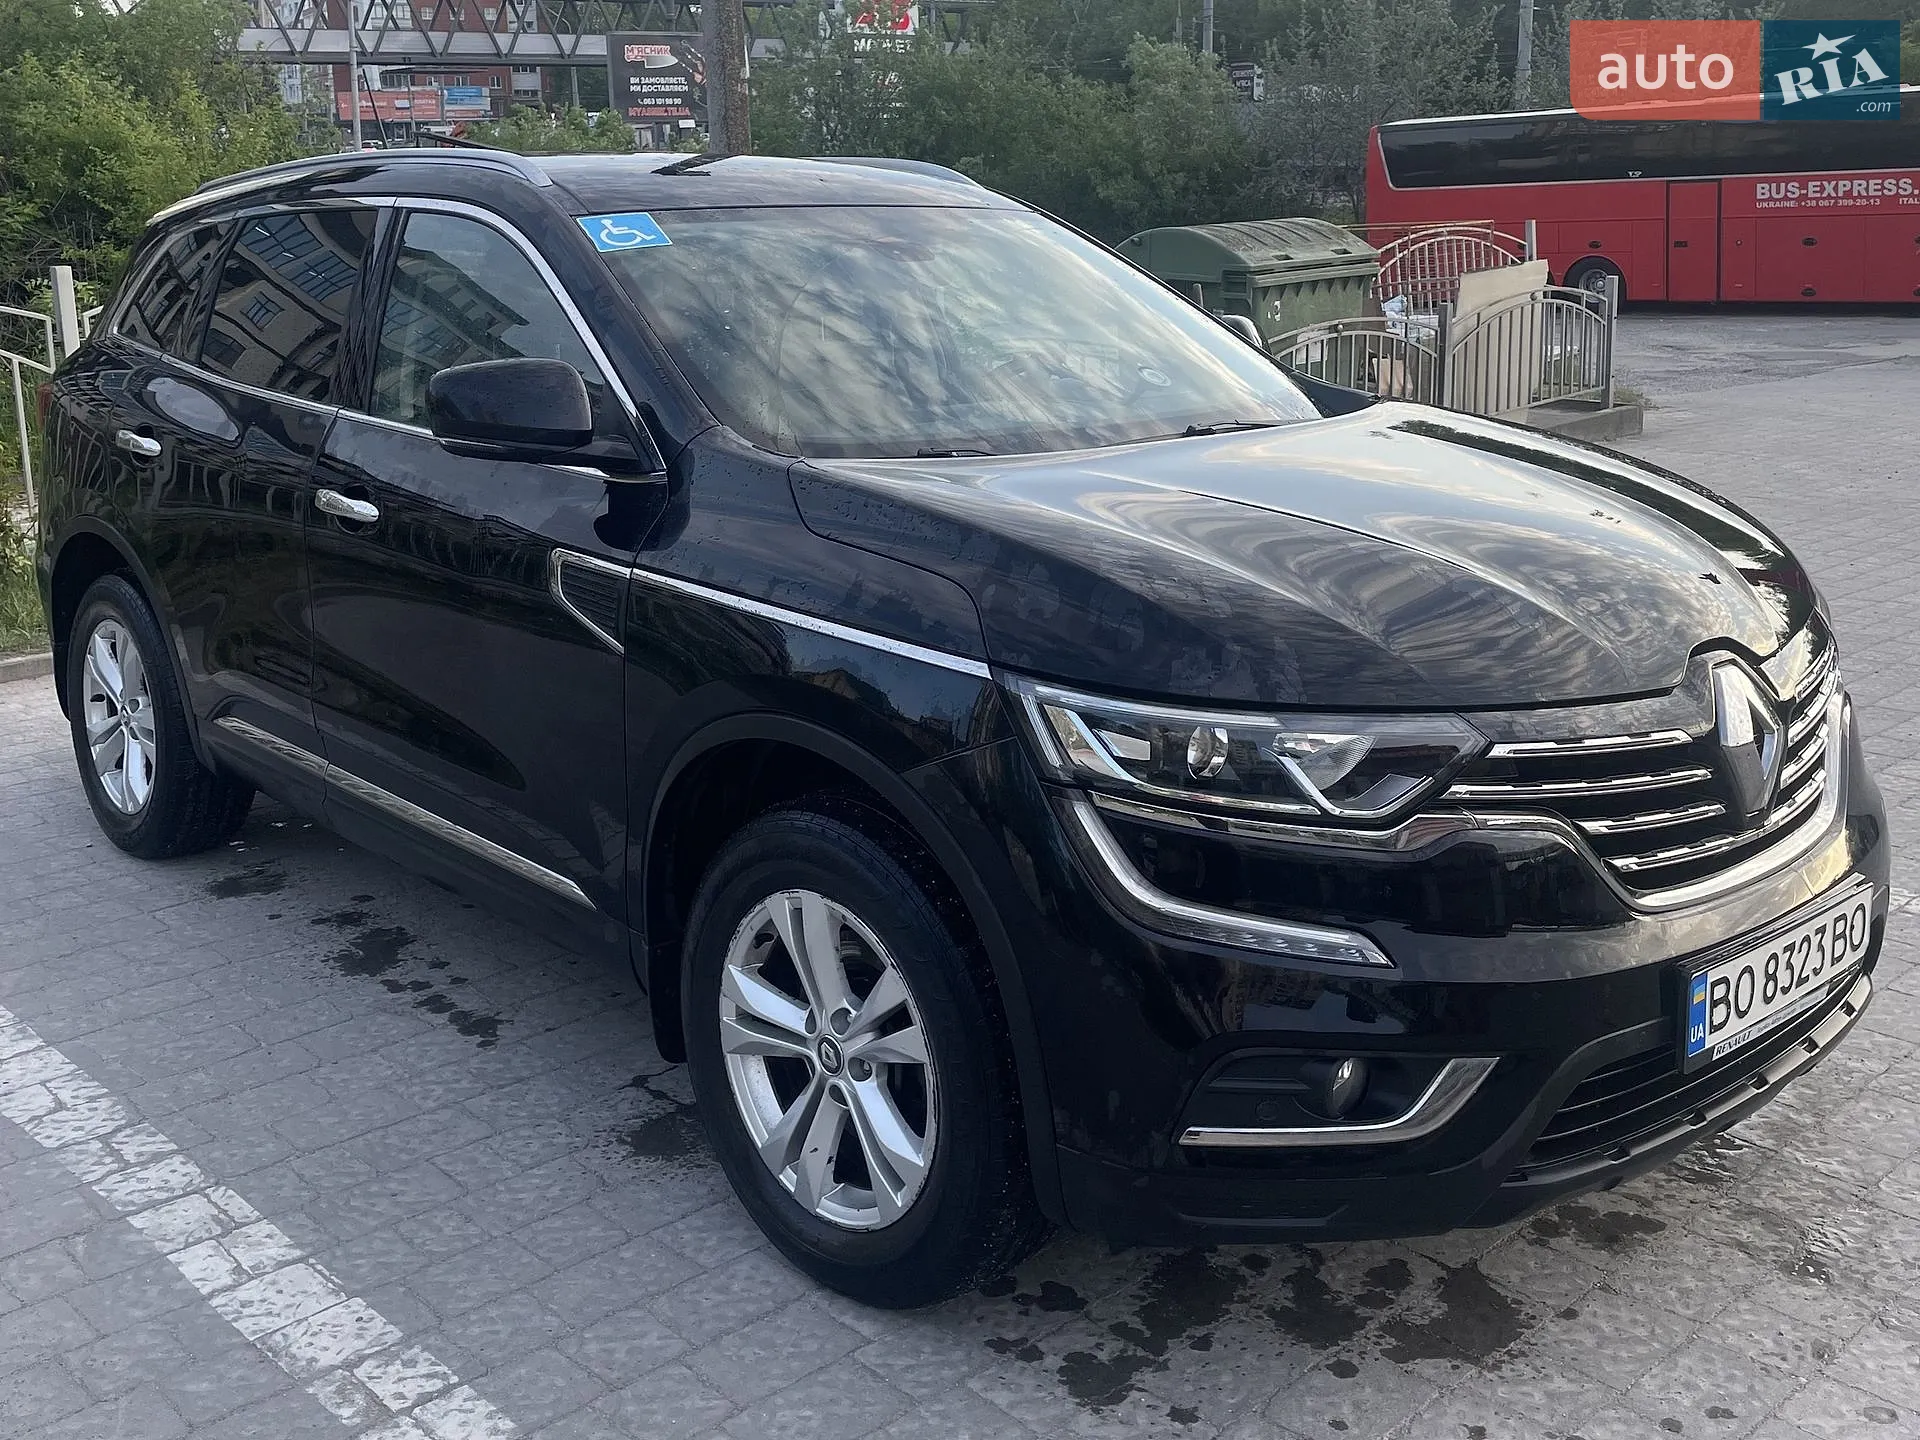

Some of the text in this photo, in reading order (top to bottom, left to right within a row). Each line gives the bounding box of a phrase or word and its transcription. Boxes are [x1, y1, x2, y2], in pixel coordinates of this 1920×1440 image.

[625, 45, 670, 56] М'ЯСНИК
[1756, 200, 1798, 209] UKRAINE:
[1708, 964, 1755, 1036] BO
[1762, 923, 1827, 1006] 8323
[1831, 902, 1866, 967] BO
[1690, 1023, 1705, 1043] UA
[1715, 1030, 1753, 1055] RENAULT
